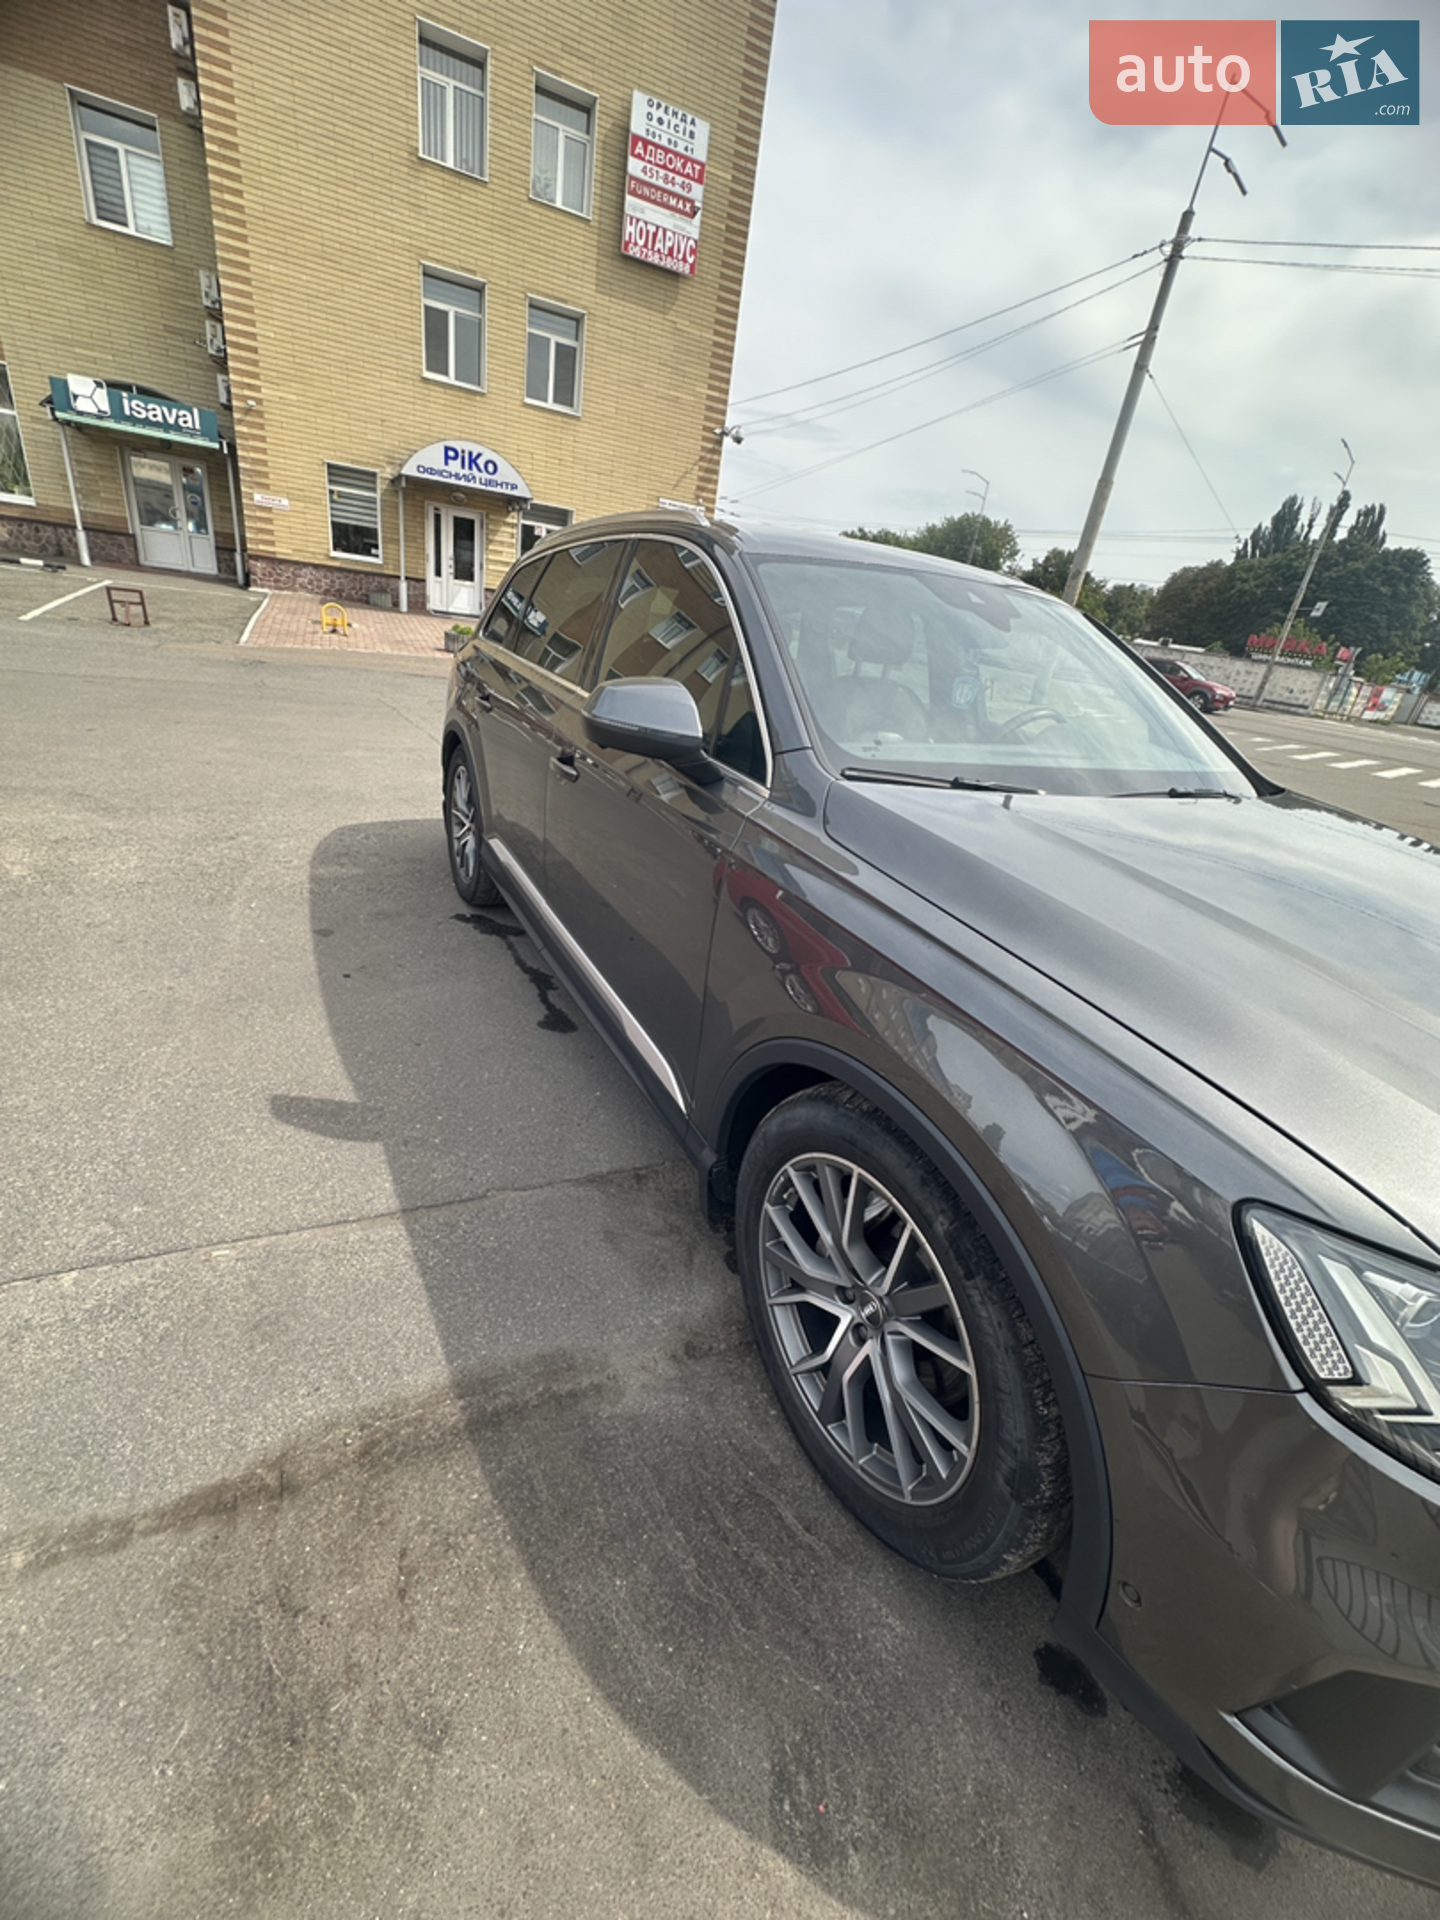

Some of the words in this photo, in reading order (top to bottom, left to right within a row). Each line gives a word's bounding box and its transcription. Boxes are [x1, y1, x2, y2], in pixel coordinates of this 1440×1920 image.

[646, 98, 696, 127] ОРЕНДА
[646, 111, 696, 140] ОФІСІВ
[634, 141, 702, 180] АДВОКАТ
[640, 163, 693, 194] 451-84-49
[630, 180, 692, 214] FUNDERMAX
[625, 215, 696, 264] НОТАРІУС
[121, 392, 202, 430] isaval
[443, 445, 498, 476] PiKo
[416, 464, 477, 484] ОФІСНИЙ
[479, 477, 519, 492] ЦЕНТР
